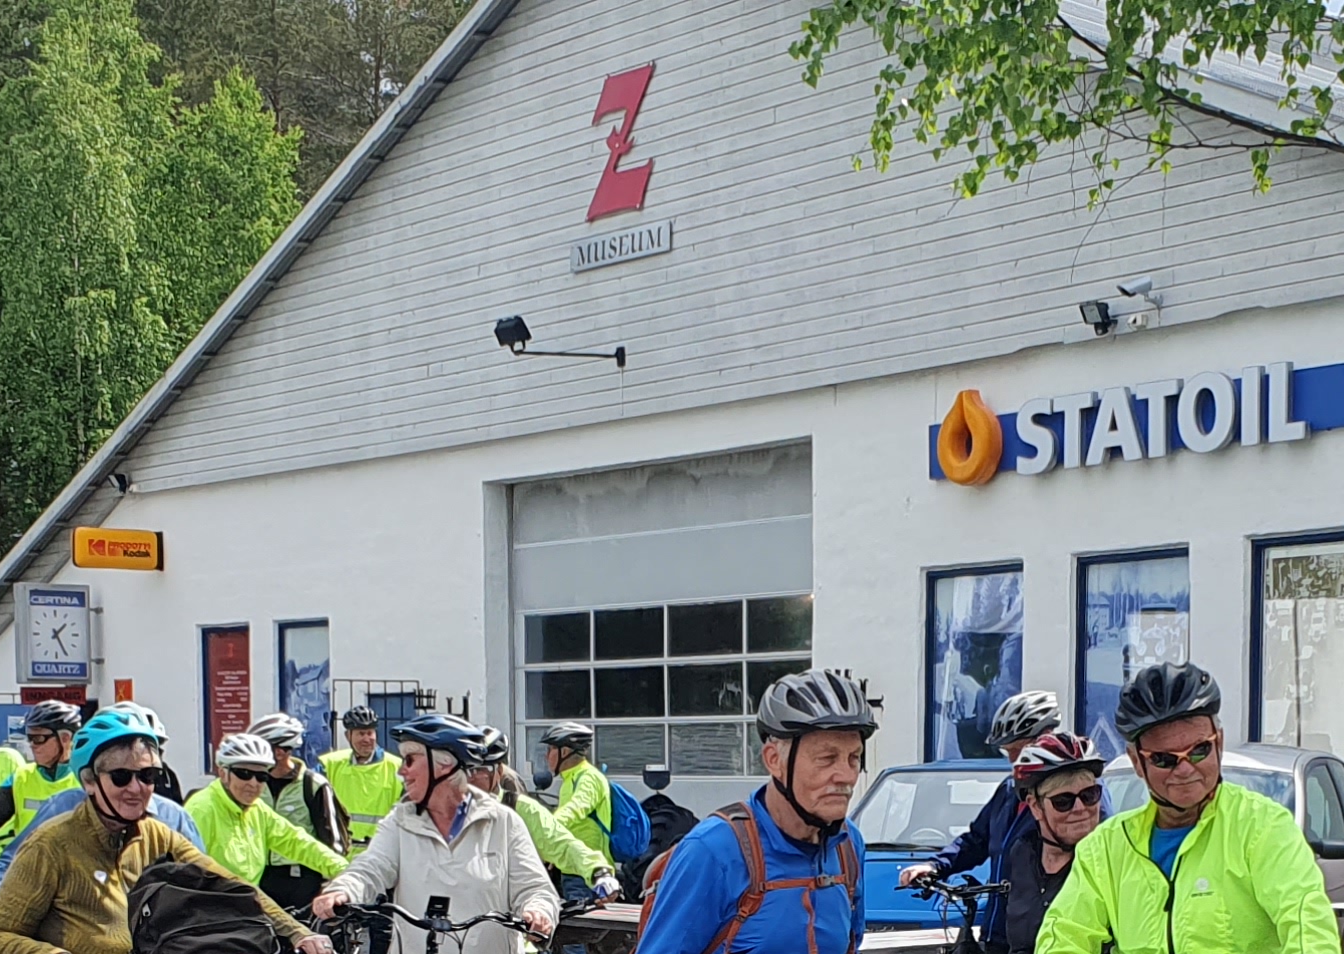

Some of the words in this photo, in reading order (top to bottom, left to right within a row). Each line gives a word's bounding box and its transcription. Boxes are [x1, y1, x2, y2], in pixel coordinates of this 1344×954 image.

[576, 226, 662, 268] MUSEUM
[1016, 361, 1310, 475] STATOIL
[123, 549, 151, 558] Kodak
[30, 596, 79, 605] CERTINA
[34, 663, 80, 674] QUARTZ
